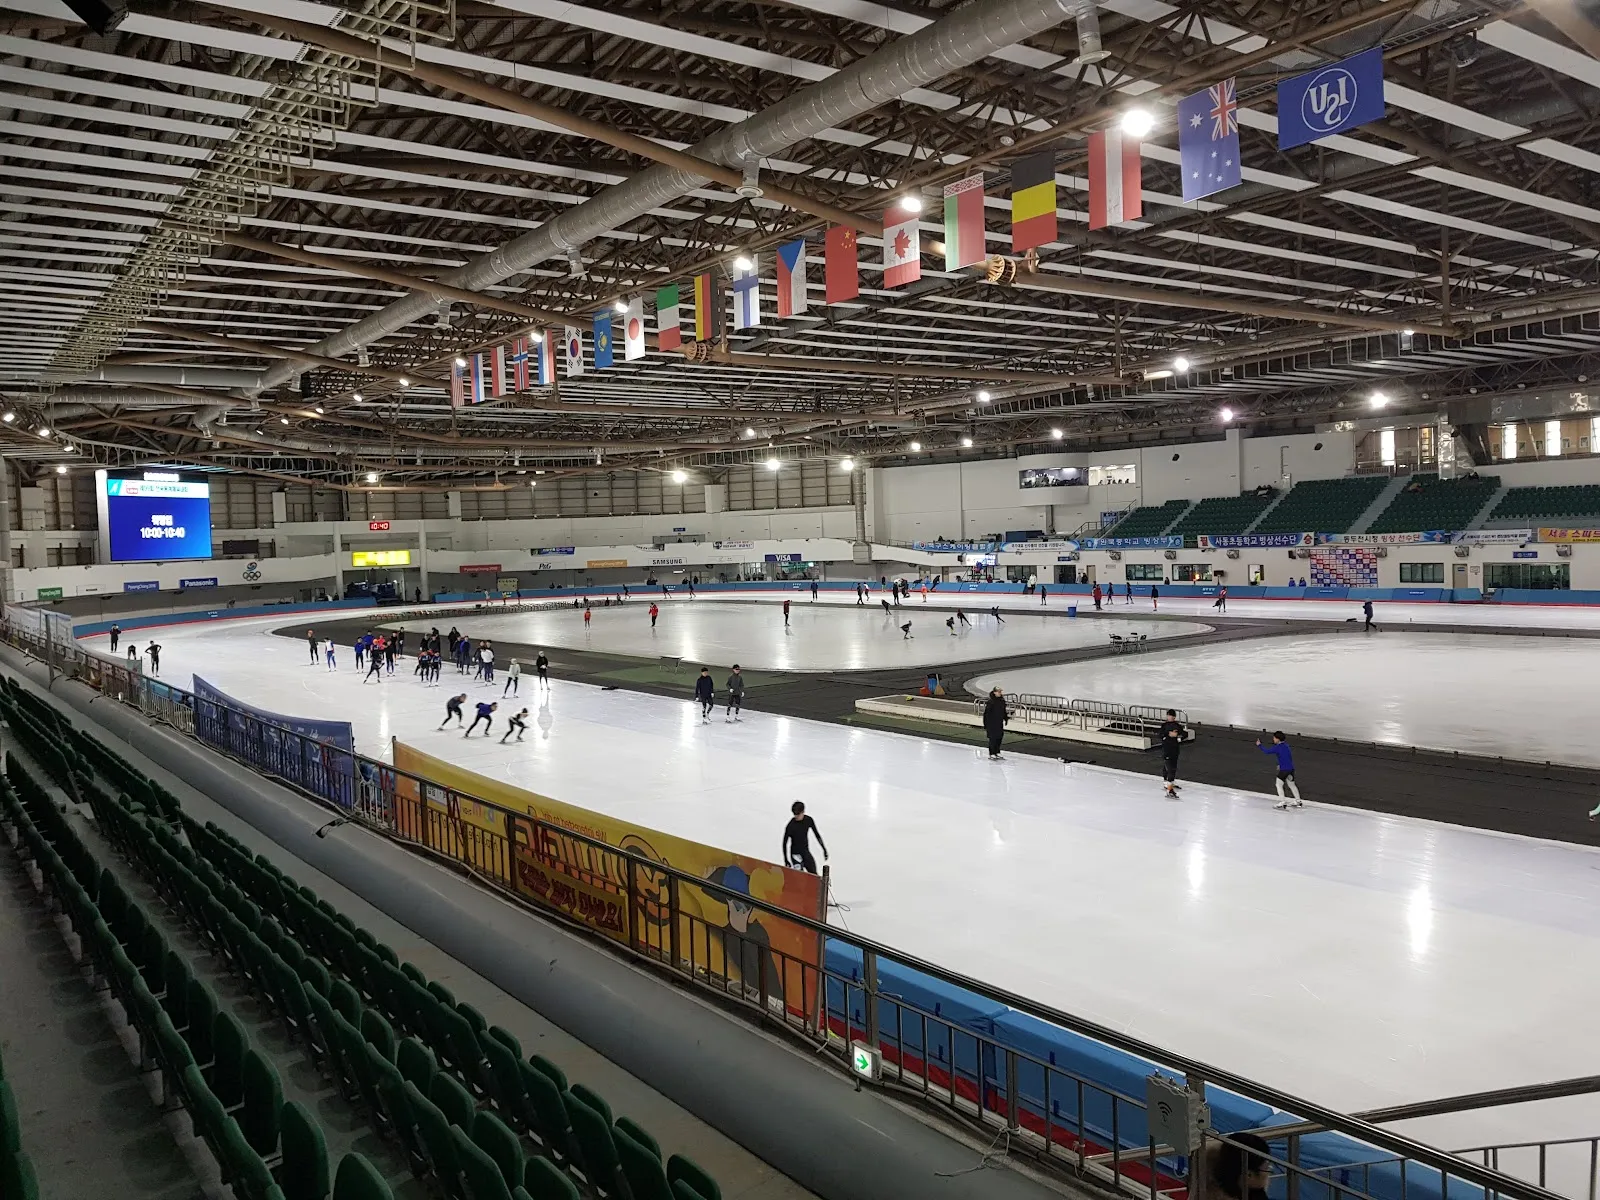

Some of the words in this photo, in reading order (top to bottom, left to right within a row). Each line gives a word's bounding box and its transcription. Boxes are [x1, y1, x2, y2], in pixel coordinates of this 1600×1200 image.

[371, 522, 389, 530] 10:40
[140, 527, 185, 538] 10:00-10:40
[1215, 536, 1258, 546] 사동초등학교
[1260, 535, 1297, 546] 빙상선수단
[1398, 534, 1421, 542] 선수단
[775, 554, 792, 562] VISA
[538, 562, 552, 570] P&G
[184, 578, 214, 587] Panasonic
